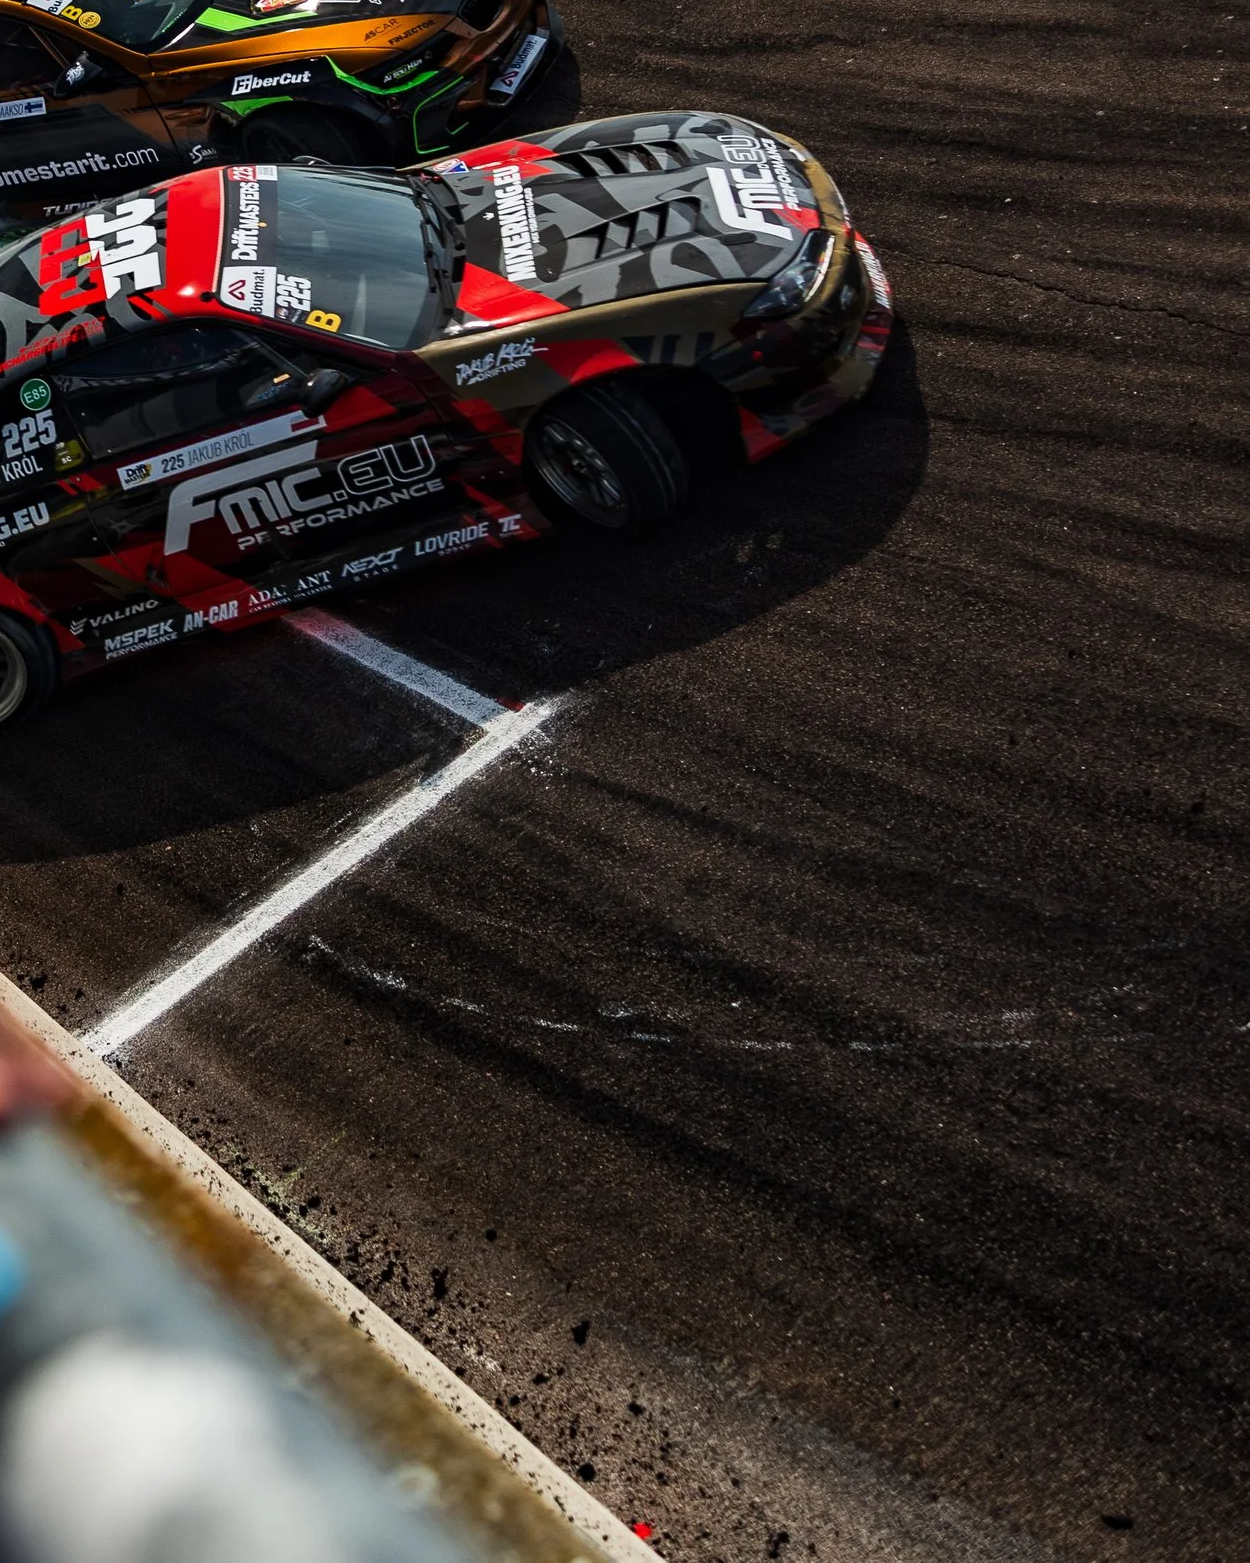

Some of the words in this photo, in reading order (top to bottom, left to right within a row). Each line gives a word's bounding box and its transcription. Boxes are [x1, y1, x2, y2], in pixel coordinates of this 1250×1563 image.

[61, 5, 83, 21] B
[388, 20, 435, 45] FINJECTOR
[511, 39, 538, 71] Budmat.
[761, 138, 802, 211] PERFORMANCE
[492, 165, 538, 282] MIXERKING.EU
[251, 269, 265, 314] Budmat.
[276, 273, 312, 311] 225
[305, 309, 342, 333] B
[475, 358, 527, 381] DRIFTING
[23, 385, 47, 404] E85
[1, 409, 58, 459] 225
[1, 454, 44, 482] KRÓL
[161, 453, 185, 474] 225
[187, 442, 223, 467] JAKUB
[224, 431, 255, 457] KRÓL
[414, 522, 490, 556] LOVRIDE
[248, 570, 331, 606] ADAANT
[89, 599, 159, 628] VALINO
[183, 600, 239, 633] AN-CAR
[104, 619, 175, 652] MSPEK
[105, 632, 178, 660] PERFORMANCE
